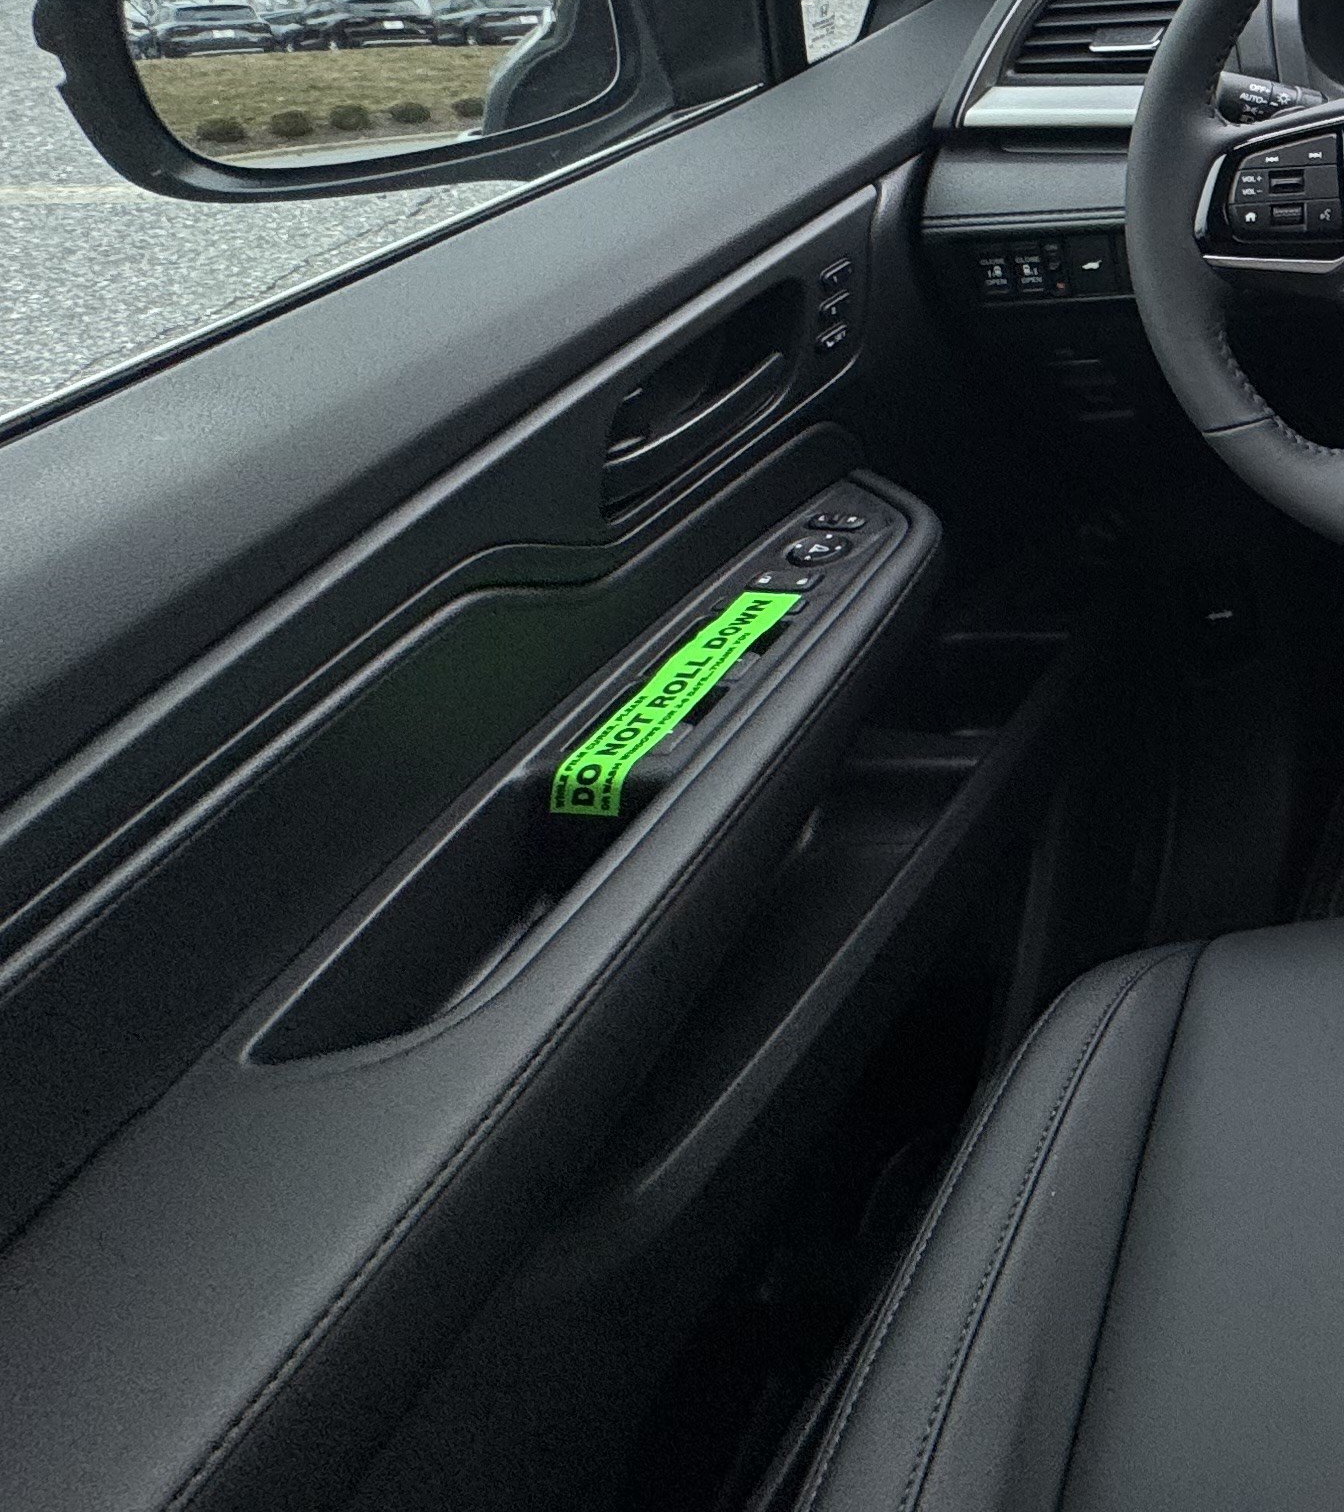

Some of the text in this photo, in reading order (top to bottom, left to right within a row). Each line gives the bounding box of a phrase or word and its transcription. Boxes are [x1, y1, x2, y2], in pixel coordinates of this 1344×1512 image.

[571, 599, 773, 806] DO NOT ROLL DOWN
